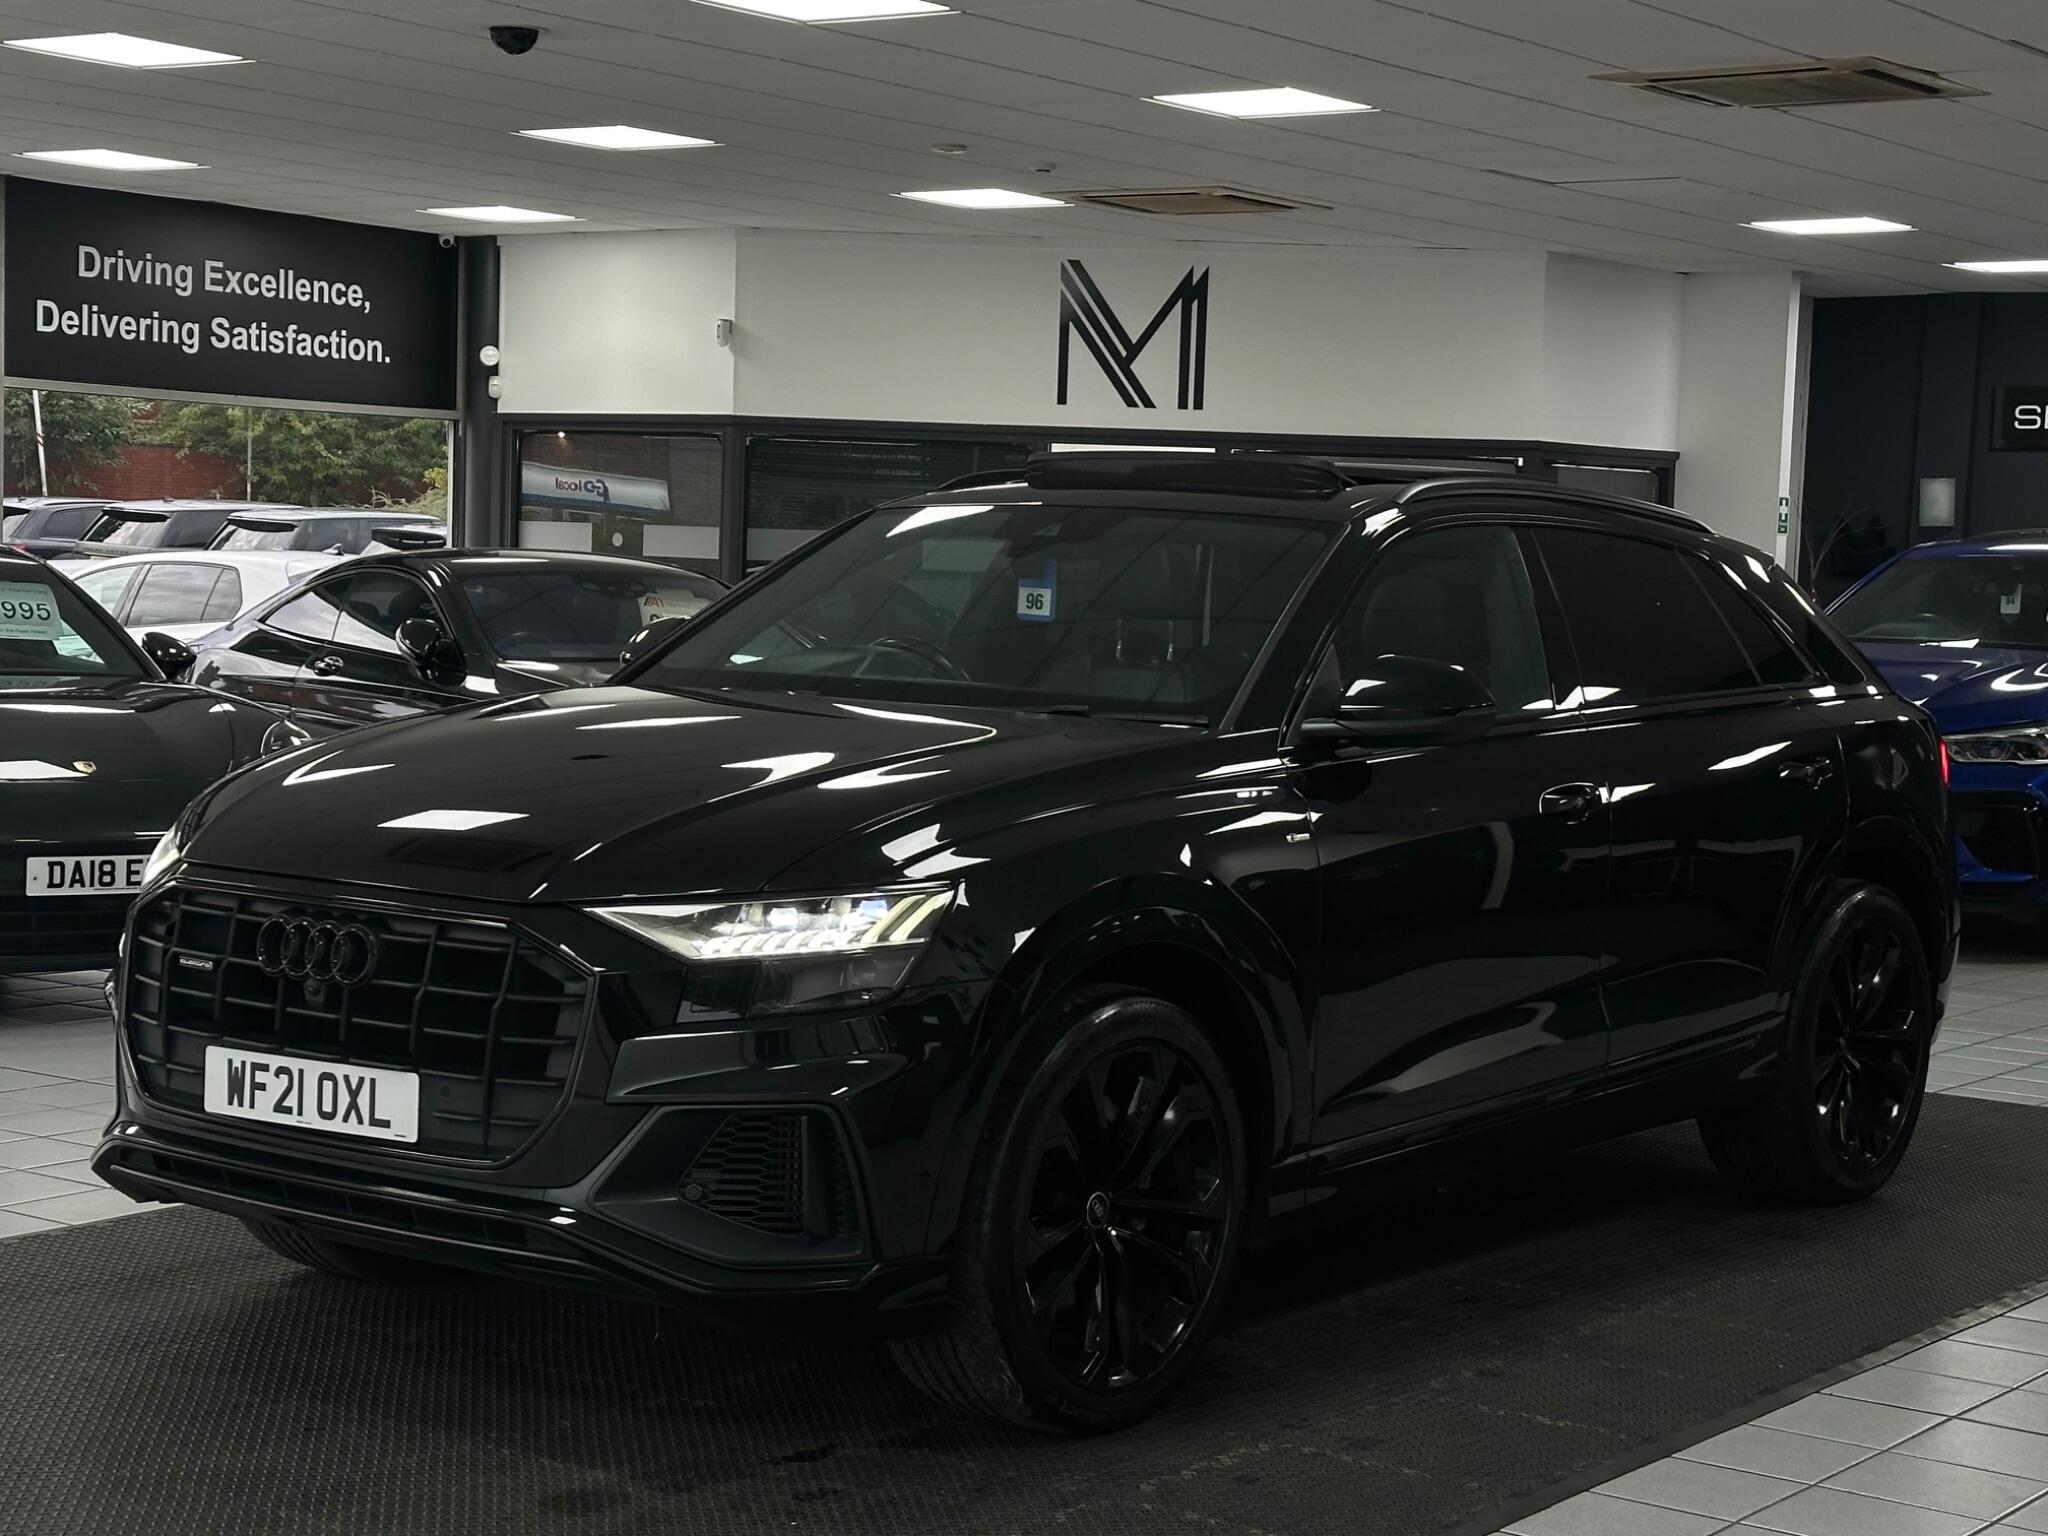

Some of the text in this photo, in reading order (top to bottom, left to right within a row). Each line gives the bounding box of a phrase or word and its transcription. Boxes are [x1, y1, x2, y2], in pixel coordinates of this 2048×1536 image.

[78, 245, 372, 314] Driving Excellence,
[36, 299, 391, 364] Delivering Satisfaction.
[1, 600, 52, 622] 995
[1025, 592, 1044, 610] 96
[46, 859, 117, 889] DA18
[227, 1057, 391, 1129] WF21 OXL
